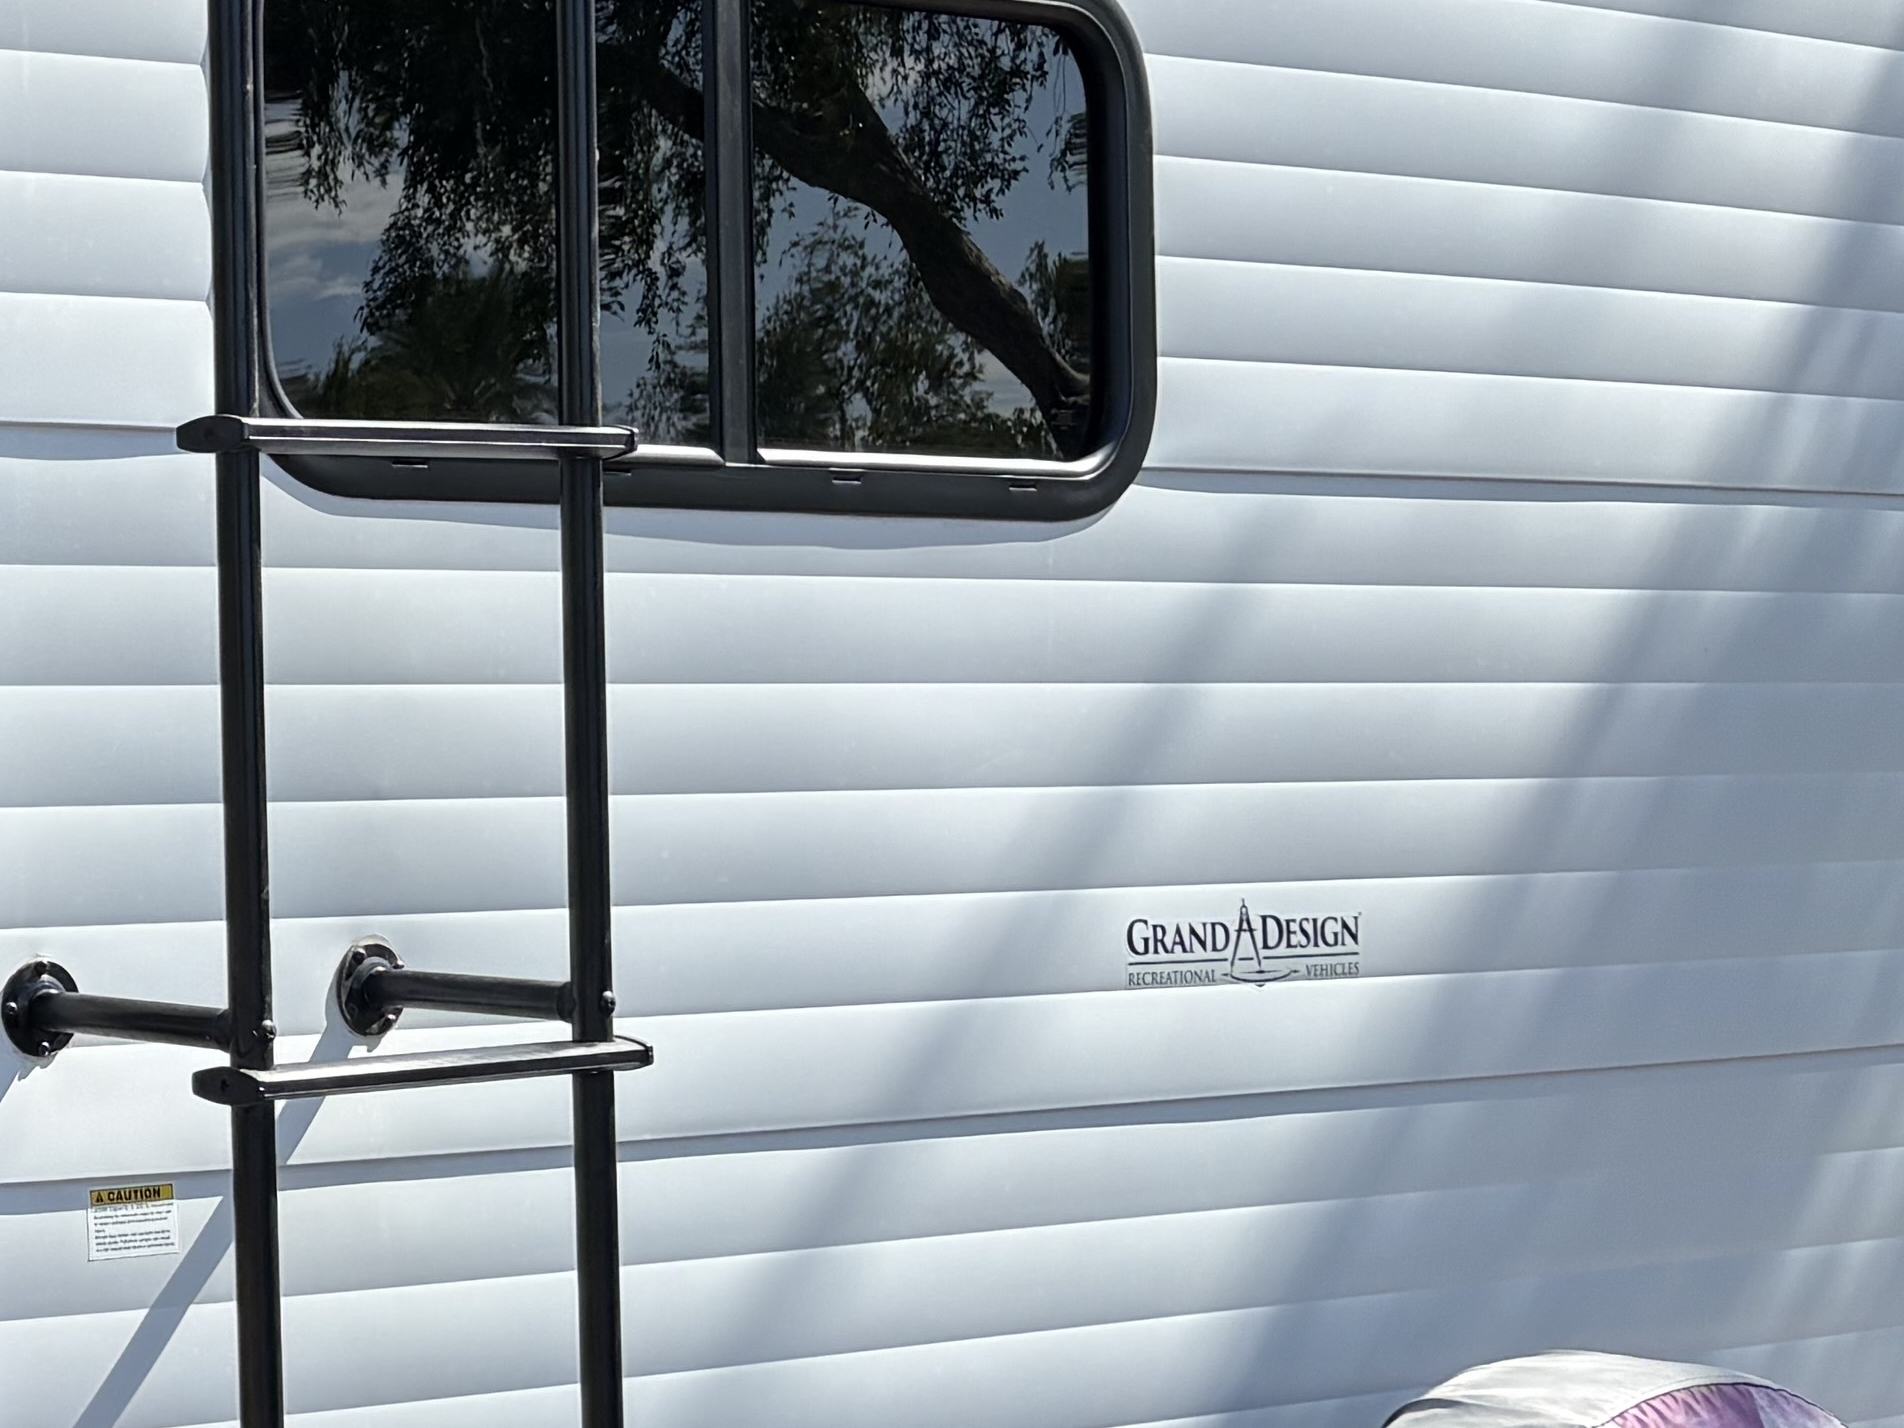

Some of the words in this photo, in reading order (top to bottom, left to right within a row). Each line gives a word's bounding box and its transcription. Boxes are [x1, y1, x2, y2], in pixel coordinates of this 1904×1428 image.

[1126, 918, 1230, 956] GRAND
[1259, 914, 1360, 950] DESIGN
[1128, 969, 1217, 987] RECREATIONAL
[1305, 962, 1360, 978] VEHICLES
[107, 1185, 161, 1202] CAUTION
